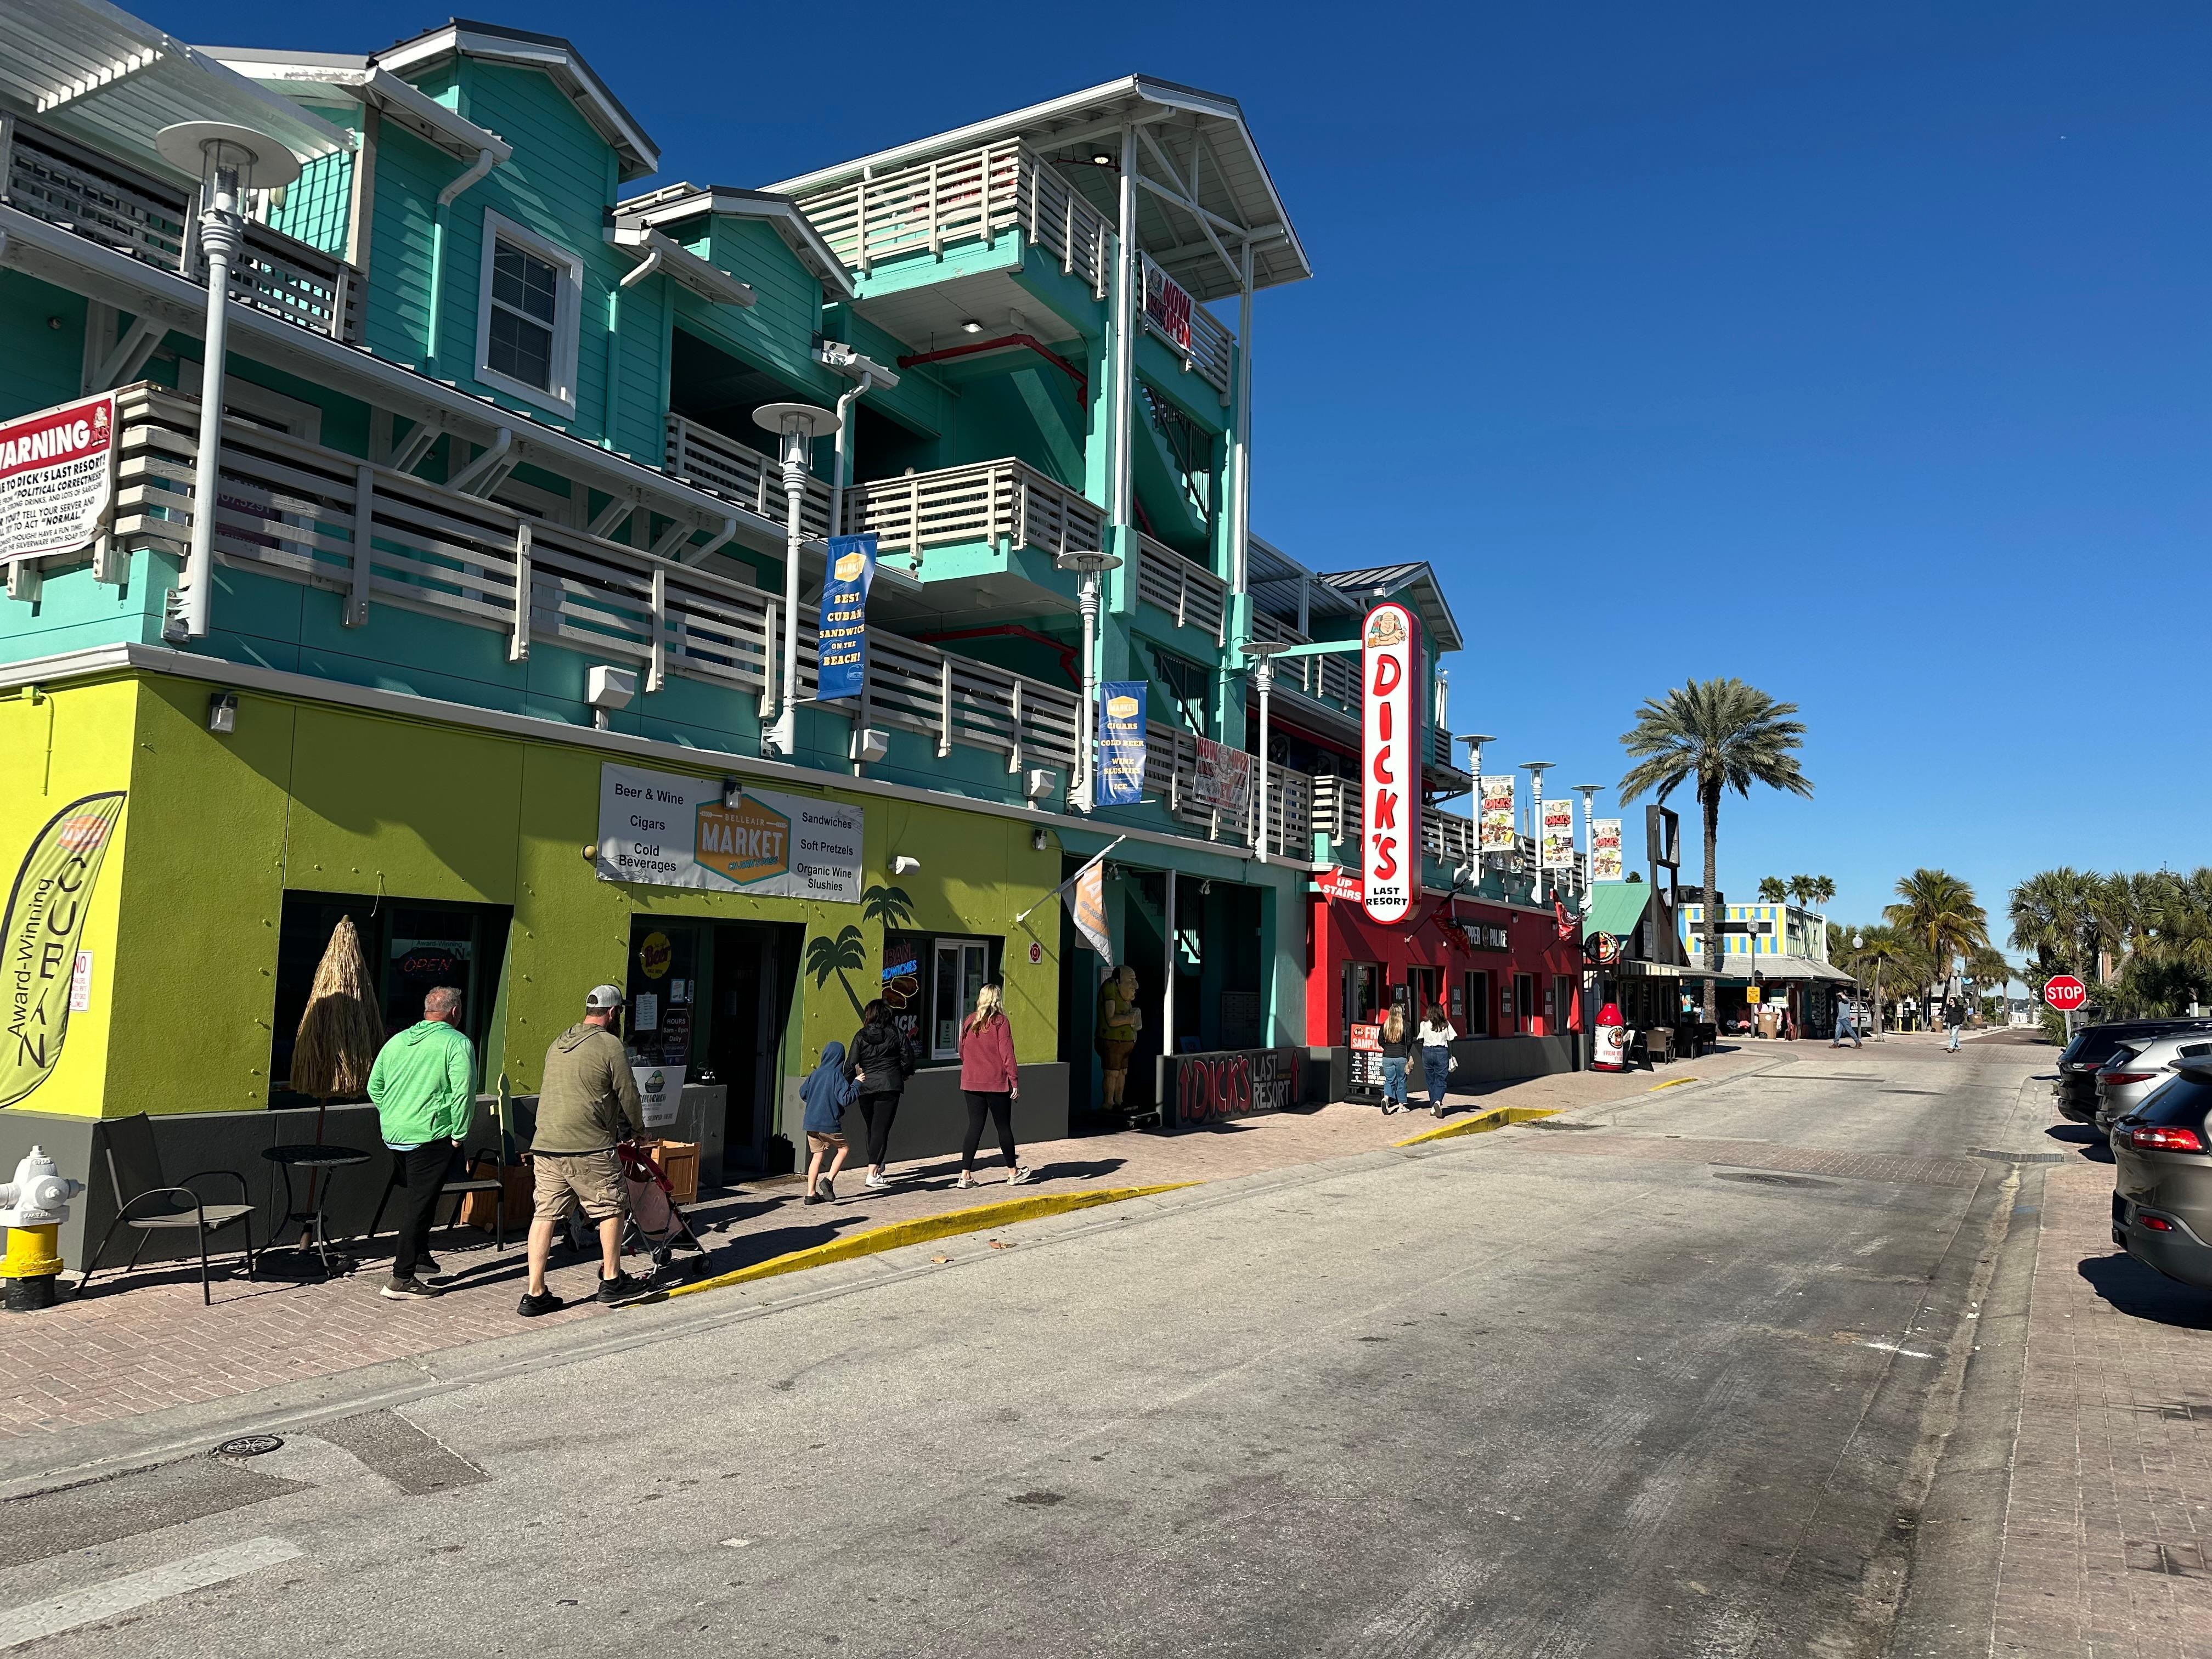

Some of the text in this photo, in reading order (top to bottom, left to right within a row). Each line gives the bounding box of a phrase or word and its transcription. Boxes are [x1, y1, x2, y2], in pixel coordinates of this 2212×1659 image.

[1163, 278, 1191, 324] NOW
[1163, 306, 1191, 350] OPEN
[7, 479, 15, 491] TO
[18, 471, 48, 487] DICK'S
[51, 466, 71, 480] LAST
[74, 454, 105, 475] RESORT!
[49, 494, 60, 502] AND
[22, 510, 37, 519] TELL
[39, 506, 58, 516] YOUR
[60, 500, 82, 512] SERVER
[83, 496, 94, 507] AND
[14, 522, 22, 531] TO
[24, 520, 38, 529] ACT
[834, 592, 860, 604] BEST
[827, 609, 862, 622] CUBAN
[819, 624, 865, 639] SANDWICH
[823, 652, 860, 666] BEACH!
[1197, 736, 1218, 761] NOW
[1372, 654, 1401, 880] DICK'S
[614, 783, 684, 805] Beer & Wine
[1485, 798, 1511, 809] DICK'S
[630, 815, 665, 831] Cigars
[725, 814, 765, 826] BELLEAIR
[802, 812, 852, 830] Sandwiches
[1545, 815, 1571, 826] DICK'S
[702, 822, 783, 860] MARKET
[800, 839, 854, 856] Soft Pretzels
[634, 843, 659, 856] Cold
[619, 855, 676, 873] Beverages
[728, 862, 738, 871] ON
[797, 863, 852, 878] Organic Wine
[808, 878, 843, 891] Slushies
[1336, 878, 1352, 888] UP
[1323, 884, 1362, 901] STAIRS
[1374, 887, 1400, 895] LAST
[1366, 898, 1407, 906] RESORT
[1462, 925, 1481, 945] EPPER
[1489, 928, 1508, 947] PALACE
[416, 940, 462, 949] Award-Winning
[7, 878, 54, 1039] Award-Winning
[18, 857, 87, 1068] CUBAN
[645, 945, 670, 967] Beer
[404, 957, 453, 972] OPEN
[2048, 986, 2082, 1000] STOP
[1452, 1004, 1462, 1015] SAUCE
[1365, 1026, 1381, 1040] FR
[1253, 1054, 1278, 1082] LAST
[1191, 1055, 1251, 1119] DICK'S
[1253, 1080, 1290, 1109] RESORT
